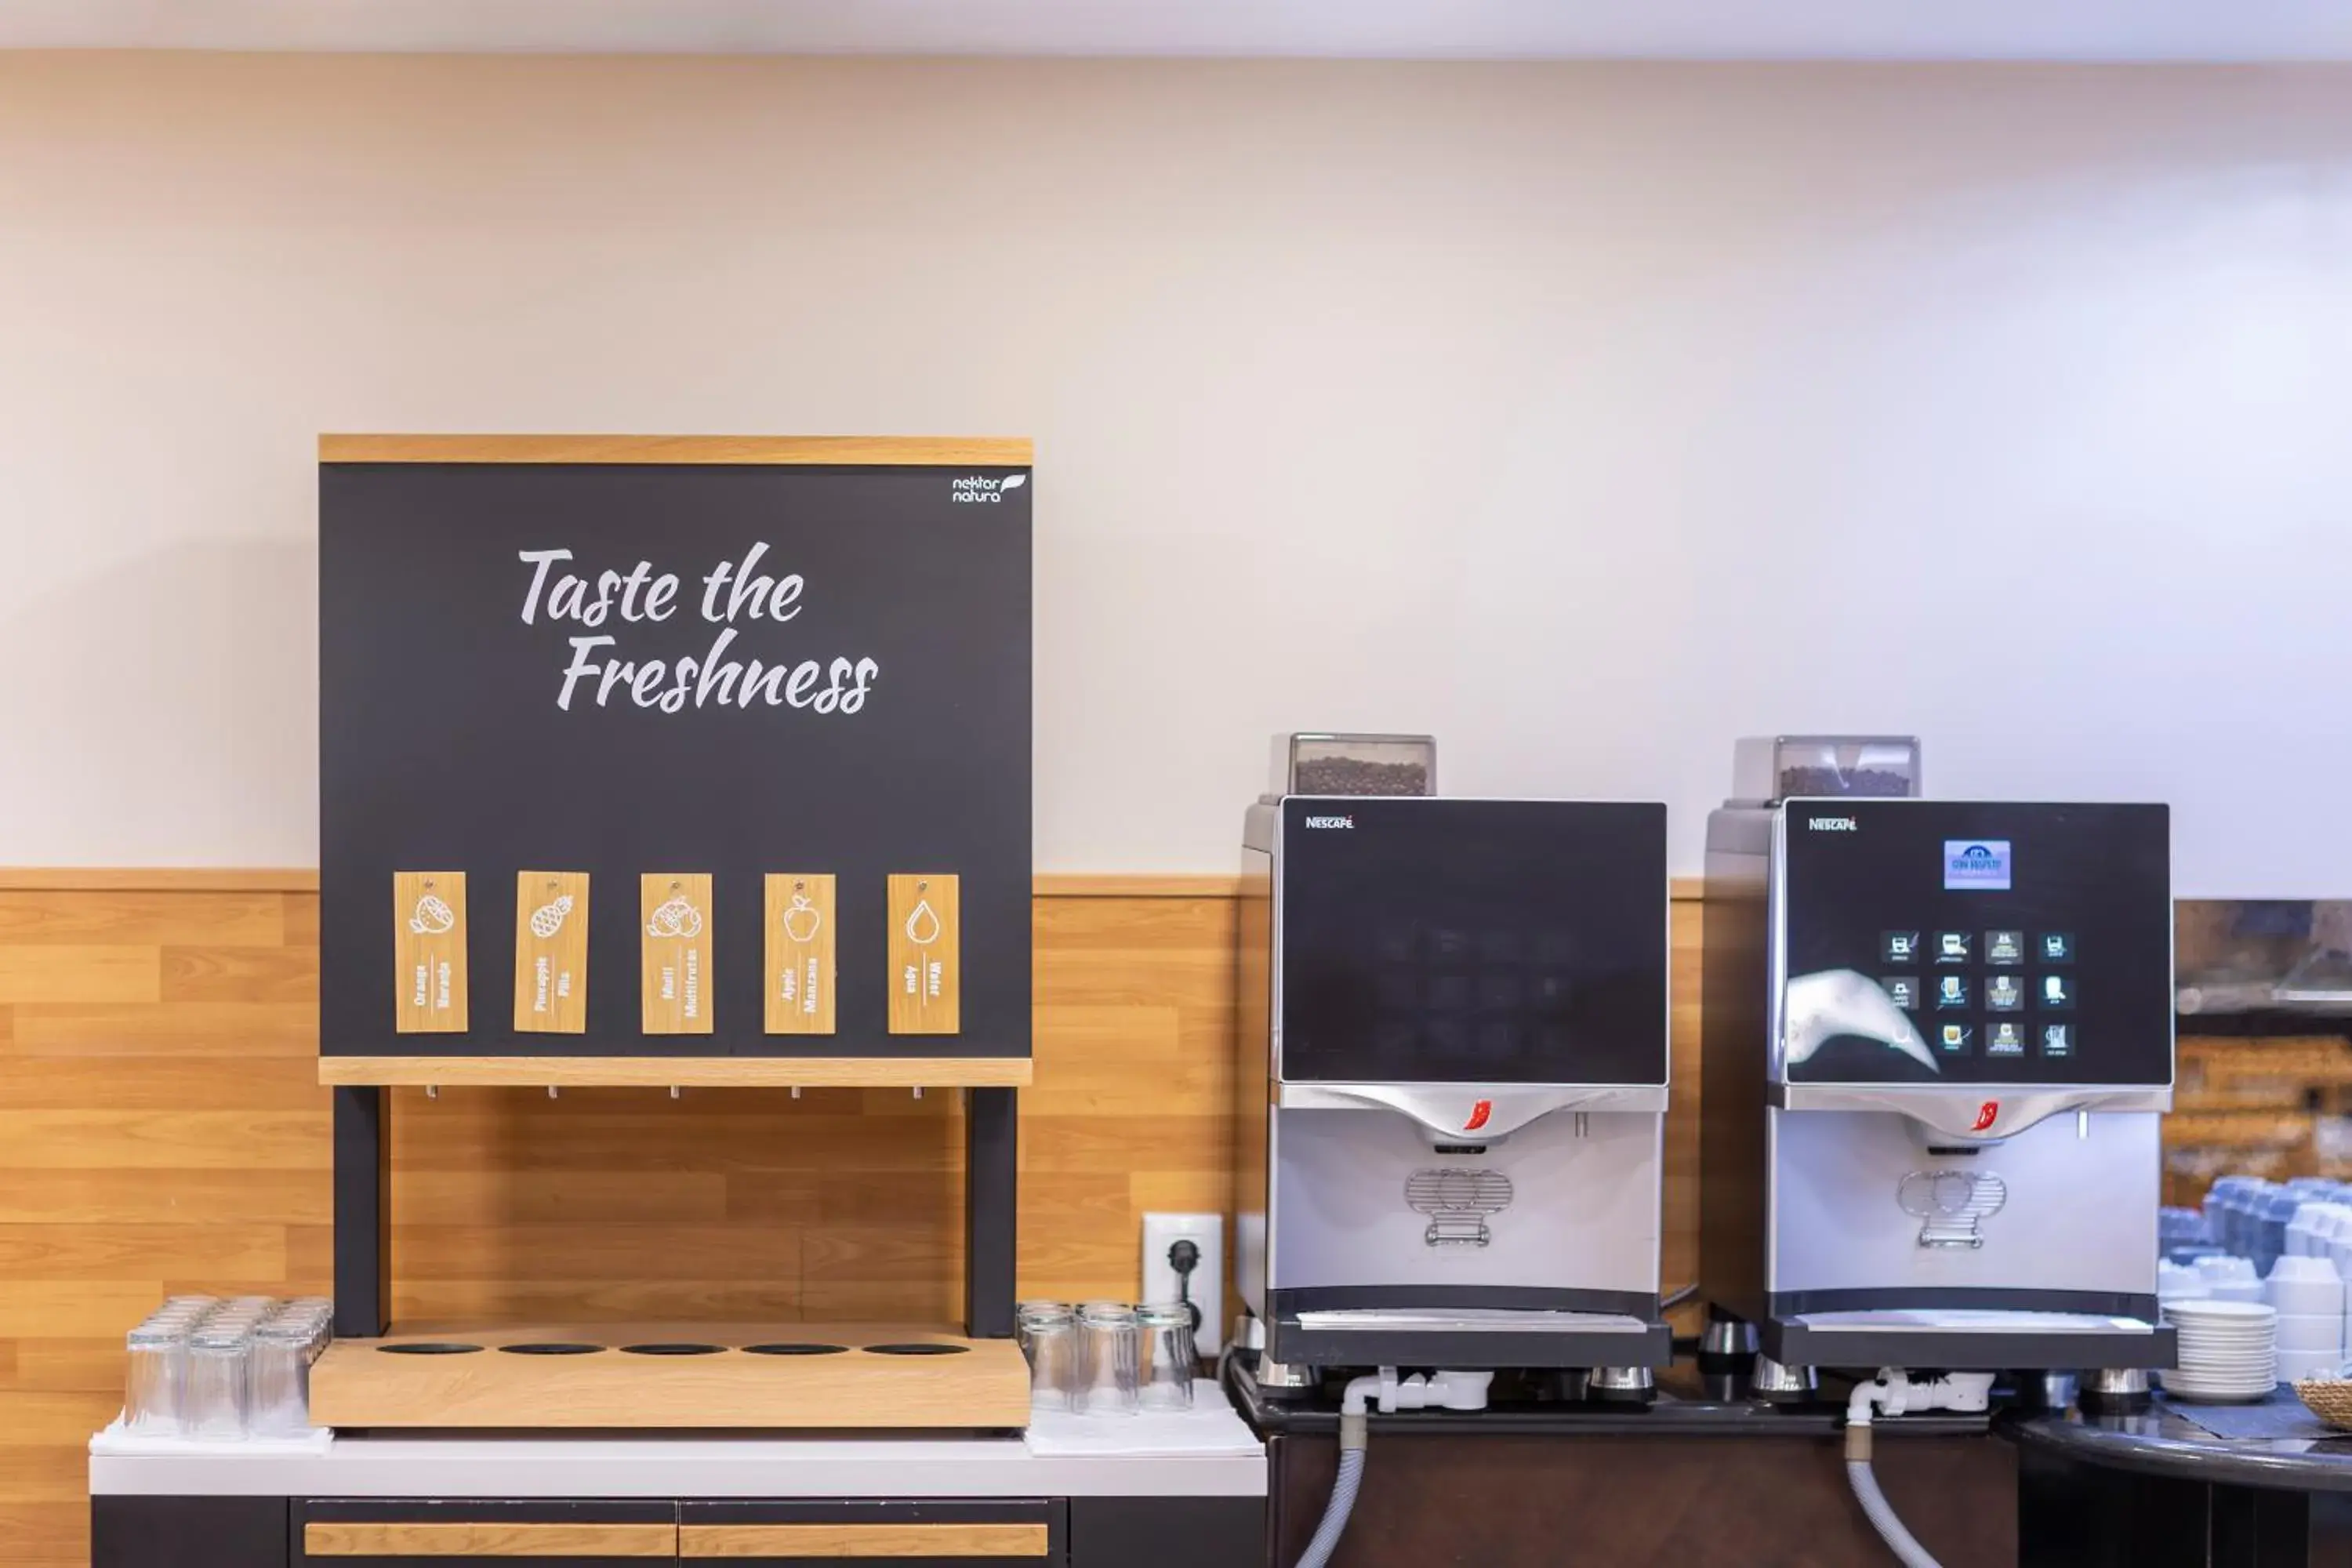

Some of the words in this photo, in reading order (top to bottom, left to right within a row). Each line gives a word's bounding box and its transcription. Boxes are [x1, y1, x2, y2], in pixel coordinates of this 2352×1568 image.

[953, 476, 1001, 489] nektar
[953, 489, 1001, 503] natura
[518, 548, 680, 627] Taste
[701, 541, 804, 623] the
[557, 627, 879, 714] Freshness
[413, 965, 427, 1007] Orange
[904, 965, 919, 993] Agua
[928, 961, 942, 997] Water
